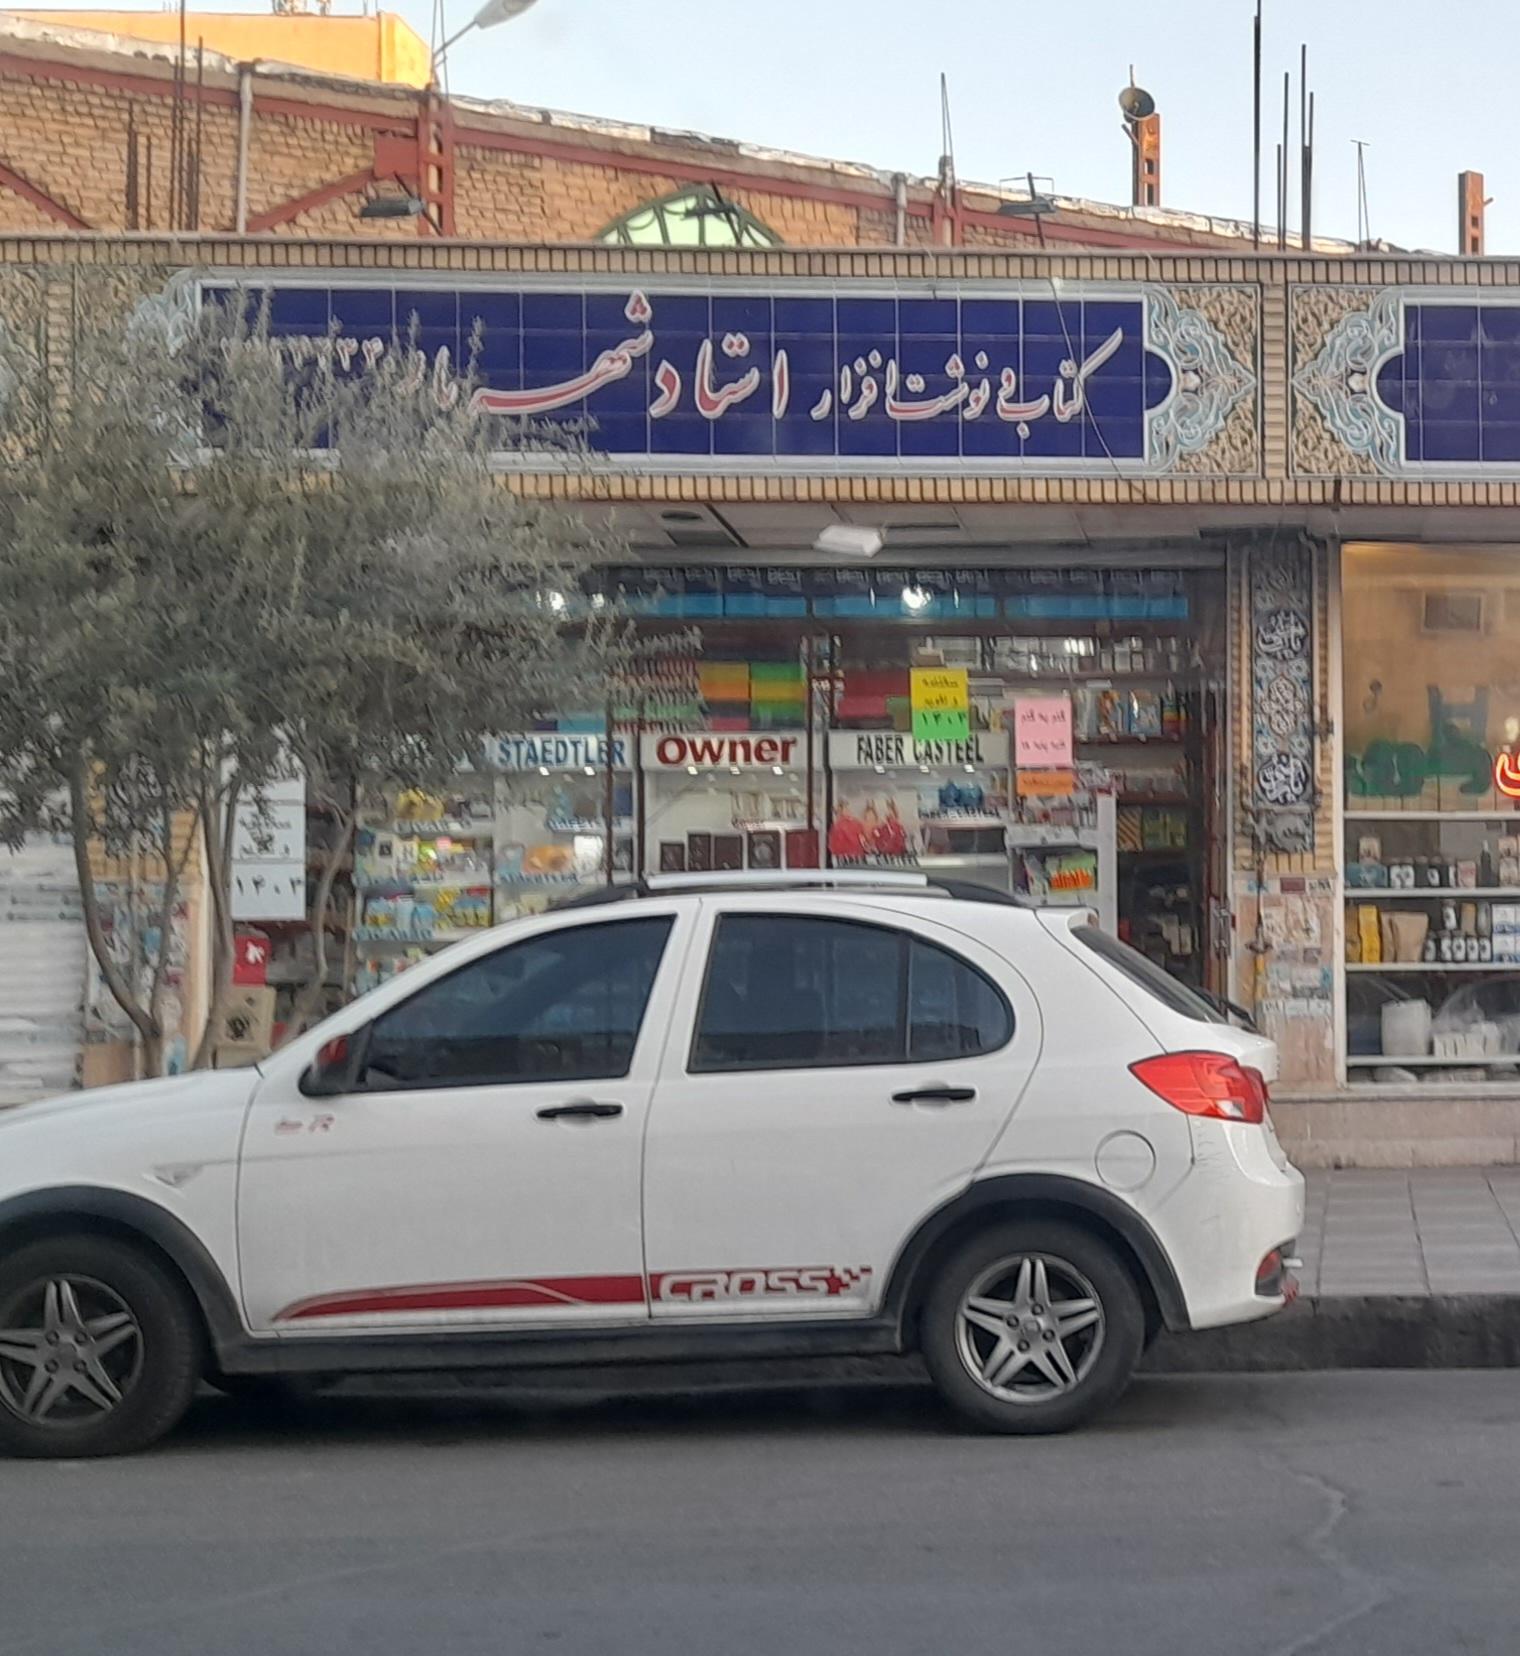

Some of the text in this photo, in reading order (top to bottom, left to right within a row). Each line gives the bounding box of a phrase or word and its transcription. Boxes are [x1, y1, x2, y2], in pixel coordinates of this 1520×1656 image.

[648, 330, 790, 421] استاد
[996, 326, 1124, 440] کتاب
[498, 738, 627, 769] STAEDTLER
[857, 734, 905, 765] FABER
[911, 732, 985, 764] CASTEEL
[658, 1270, 831, 1302] CROSS
